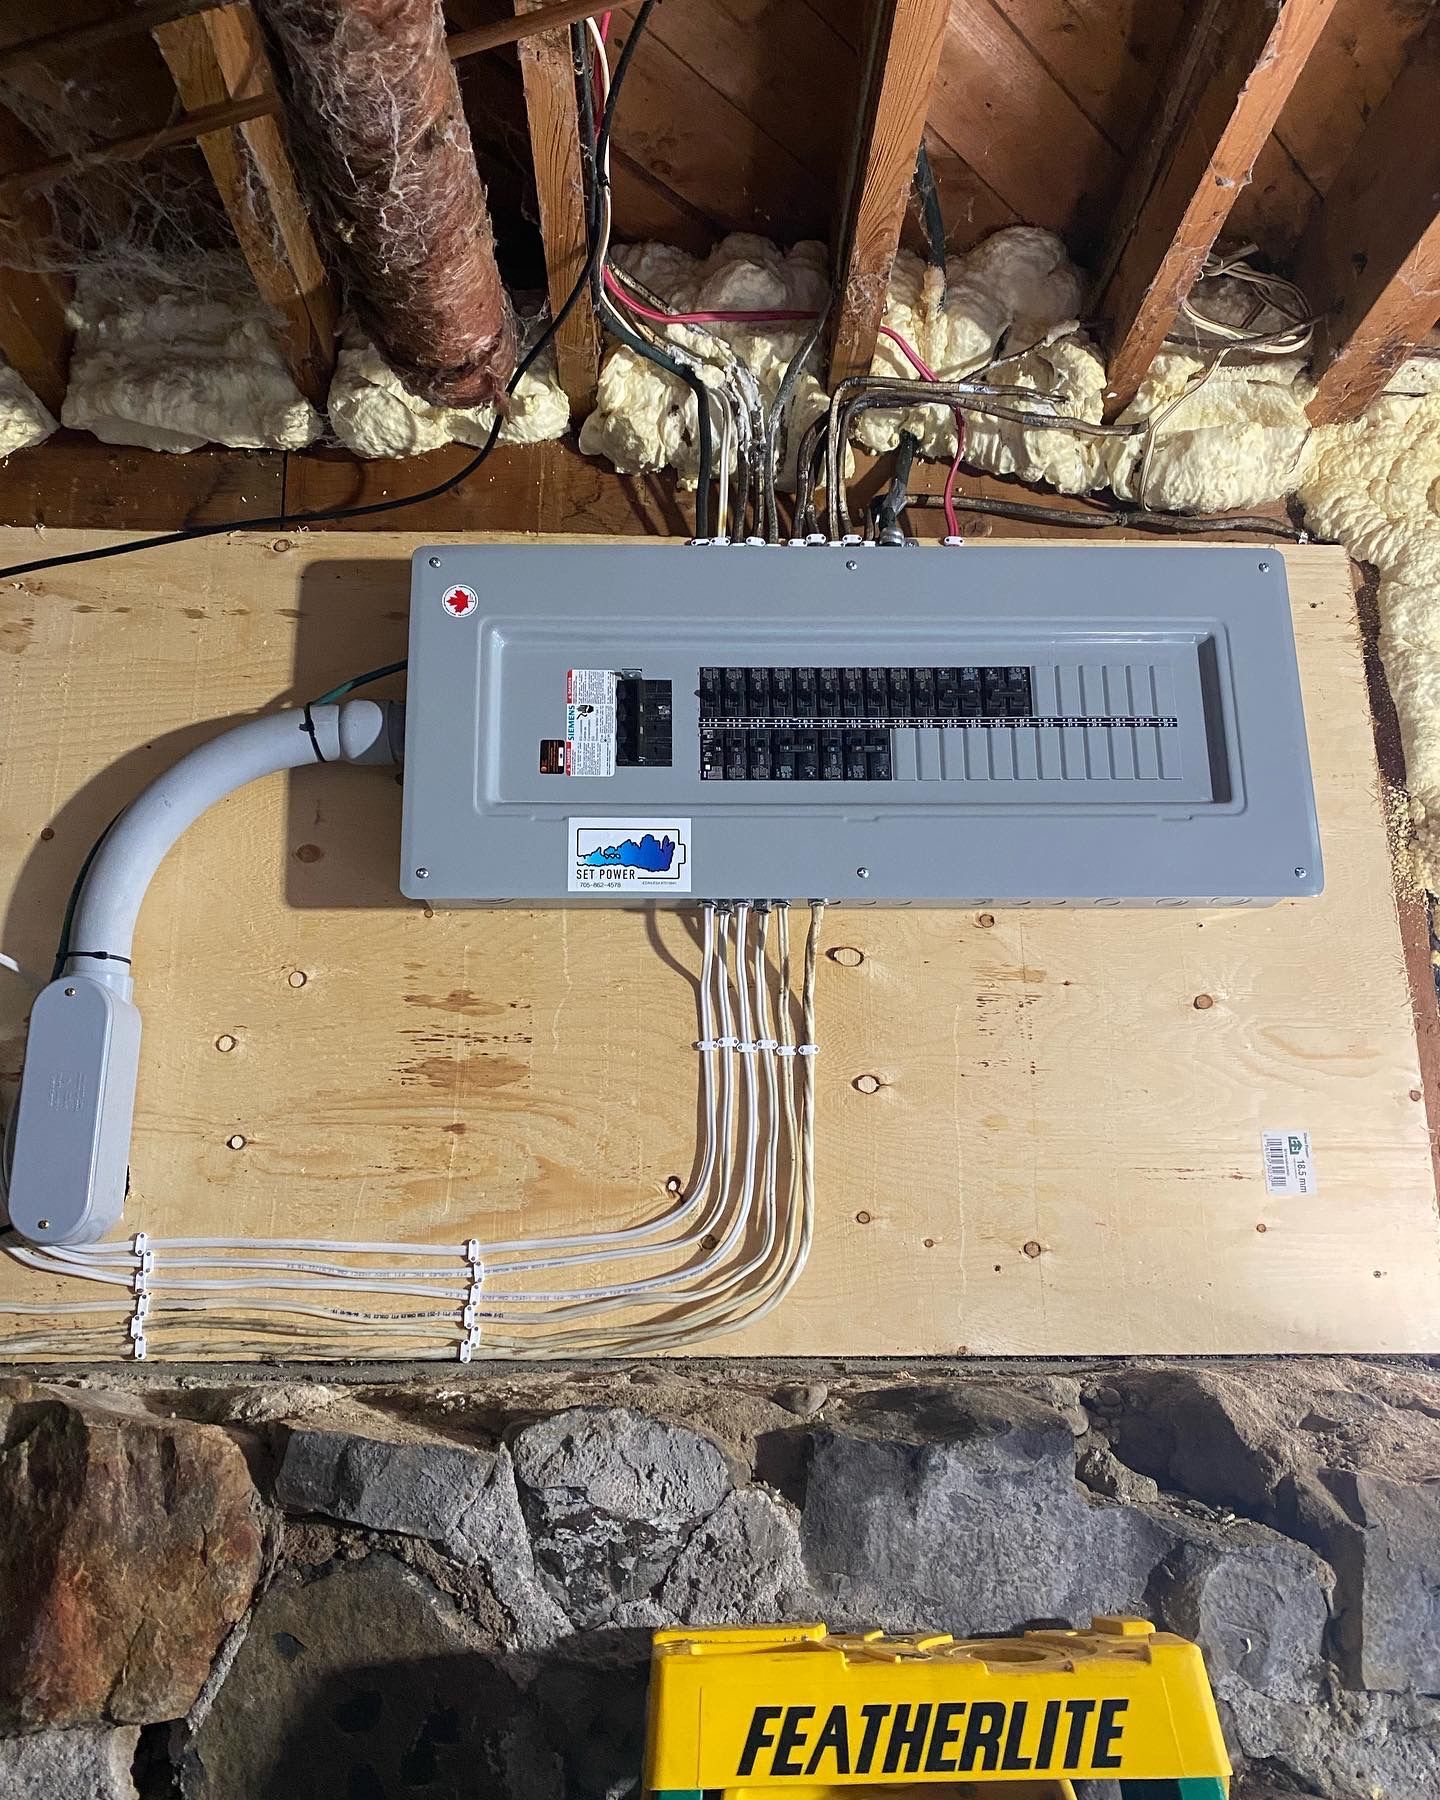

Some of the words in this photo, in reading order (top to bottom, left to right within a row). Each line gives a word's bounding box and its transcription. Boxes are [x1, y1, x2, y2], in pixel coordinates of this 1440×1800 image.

[576, 869, 595, 880] SET
[600, 869, 636, 880] POWER
[1297, 1160, 1307, 1176] 18.5
[1299, 1178, 1307, 1193] mm
[736, 1698, 1129, 1777] FEATHERLITE
